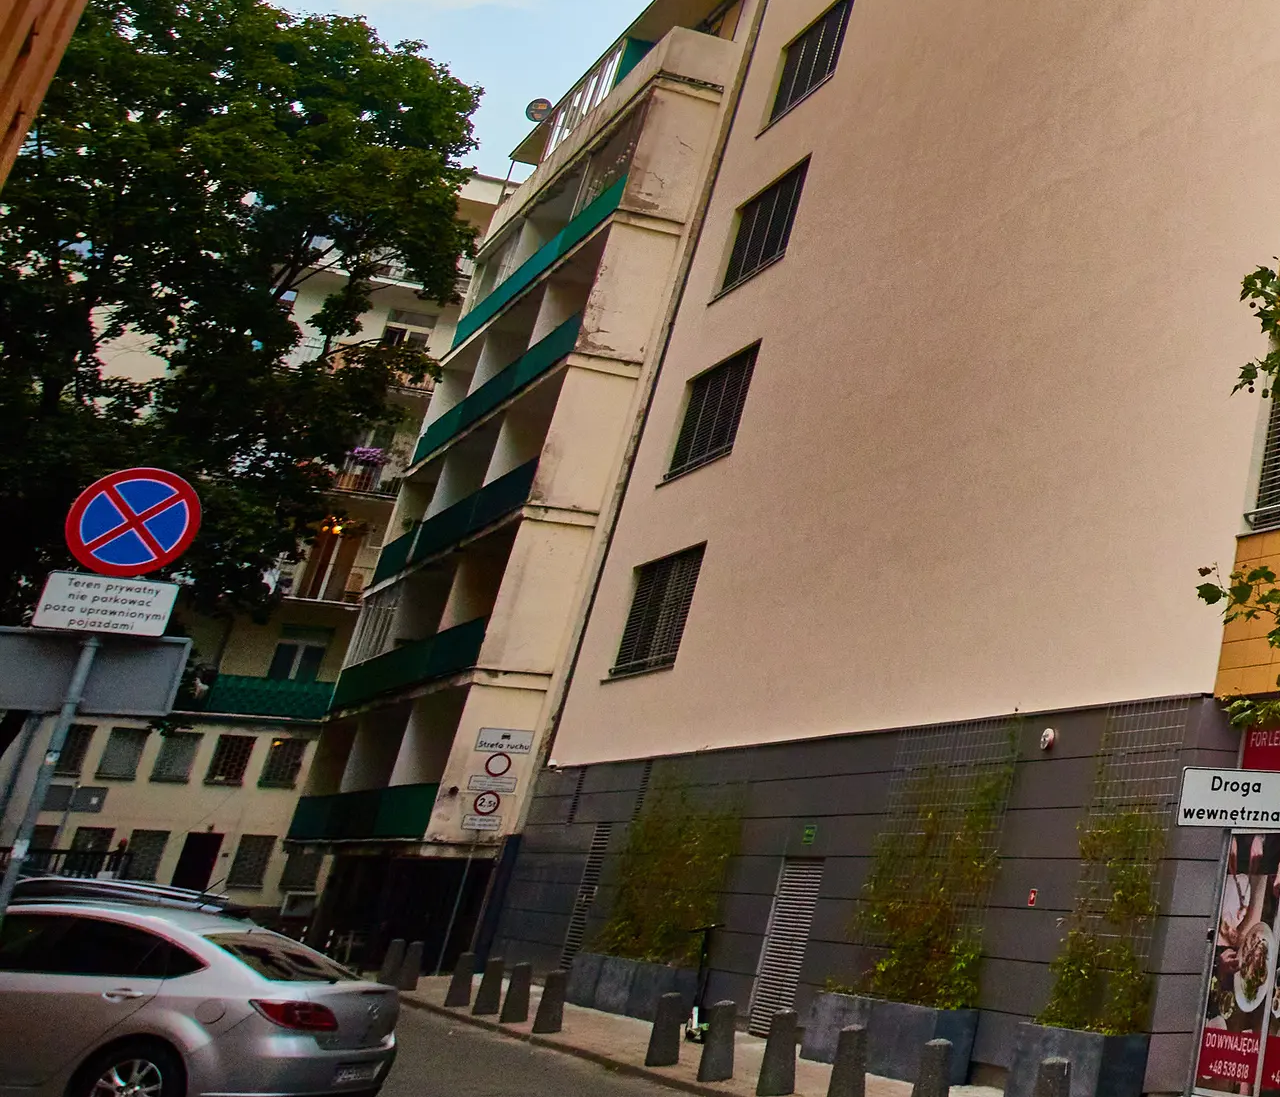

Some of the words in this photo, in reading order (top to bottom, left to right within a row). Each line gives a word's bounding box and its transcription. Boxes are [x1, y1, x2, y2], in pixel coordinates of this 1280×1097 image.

[67, 577, 101, 589] Teren
[105, 582, 161, 598] prywatny
[67, 591, 87, 601] nie
[43, 602, 75, 613] poza
[80, 606, 167, 622] uprawnionymi
[67, 617, 135, 631] pojazdami
[478, 740, 503, 749] Strefa
[1250, 731, 1267, 747] FOR
[1211, 775, 1262, 797] Droga
[478, 797, 496, 808] 2,5t
[1183, 806, 1280, 825] wewnętrzna
[1205, 1032, 1217, 1048] DO
[1217, 1034, 1260, 1056] WYNAJĘCIA
[1208, 1060, 1223, 1075] +48
[1223, 1062, 1237, 1077] 538
[1236, 1063, 1249, 1079] 818
